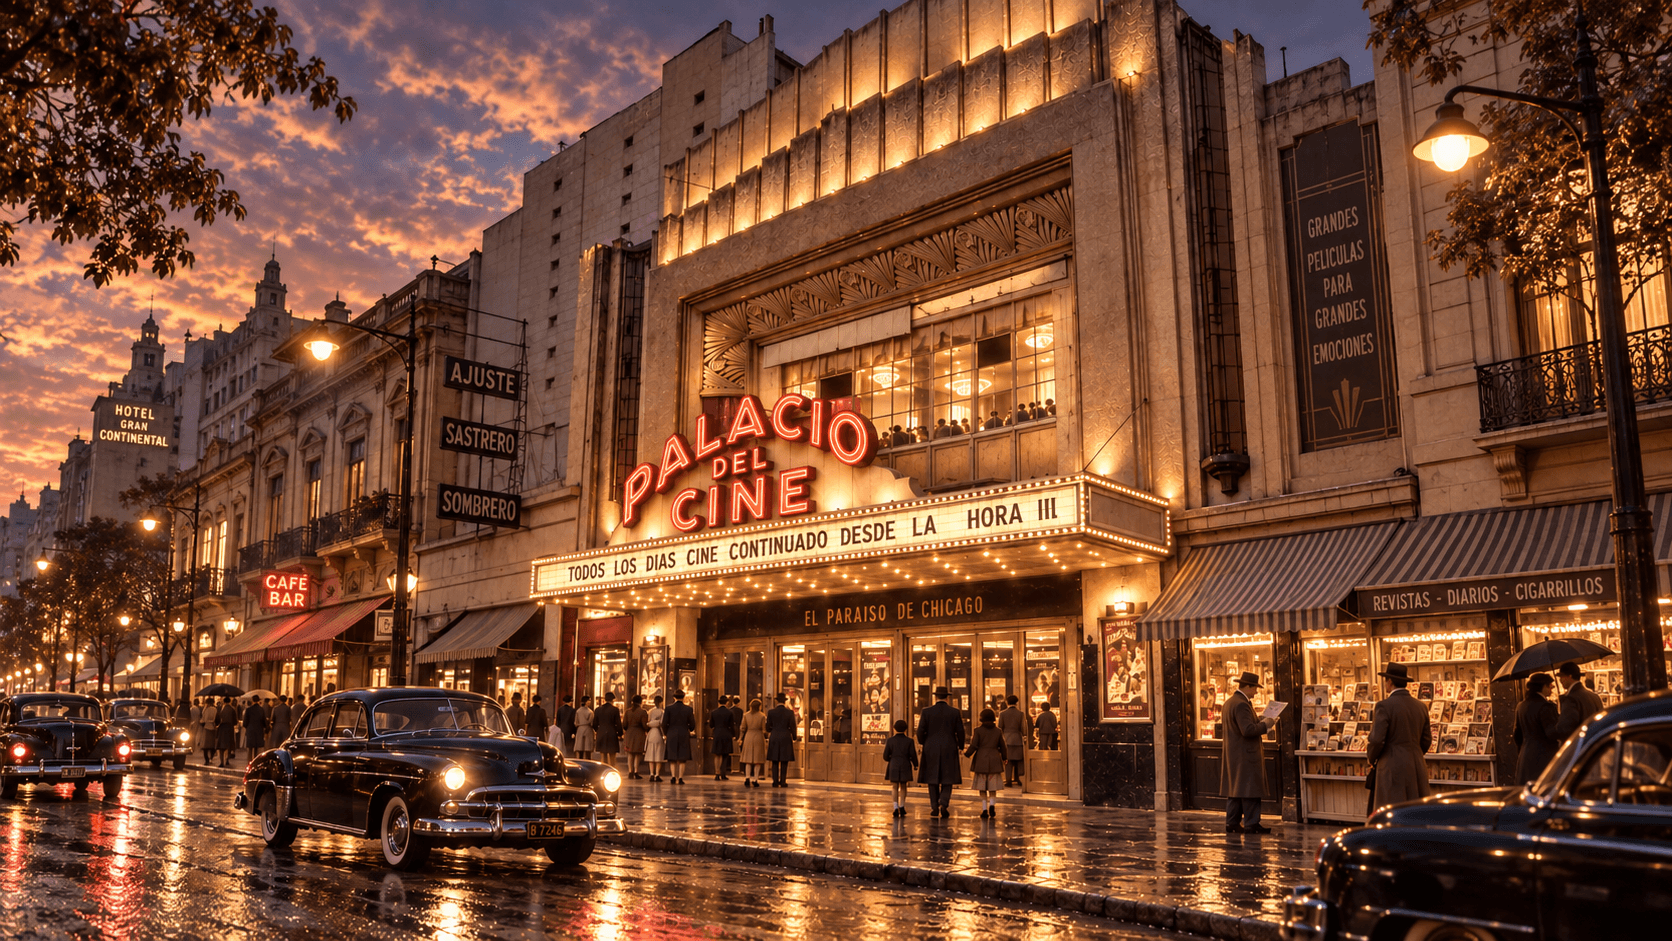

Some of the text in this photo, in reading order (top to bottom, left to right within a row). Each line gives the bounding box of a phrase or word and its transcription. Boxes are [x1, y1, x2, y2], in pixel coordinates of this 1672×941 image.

[1307, 206, 1359, 238] GRANDES
[1307, 239, 1365, 273] PELICULAS
[1323, 272, 1354, 298] PARA
[1315, 298, 1367, 329] GRANDES
[1313, 333, 1375, 365] EMOCIONES
[450, 362, 516, 394] AJUSTE
[115, 404, 155, 420] HOTEL
[120, 419, 148, 431] GRAN
[99, 429, 169, 447] CONTINENTAL
[445, 423, 515, 454] SASTRERO
[623, 393, 871, 528] PALACIO
[711, 447, 767, 480] DEL
[442, 490, 516, 521] SOMBRERO
[671, 465, 810, 532] CINE
[568, 562, 605, 582] TODOS
[614, 558, 637, 576] LOS
[646, 551, 676, 572] DIAS
[686, 546, 718, 566] CINE
[729, 530, 828, 560] CONTINUADO
[840, 520, 896, 546] DESDE
[912, 515, 937, 537] LA
[967, 503, 1023, 530] HORA
[265, 574, 308, 591] CAFÉ
[1373, 591, 1431, 611] REVISTAS
[1447, 585, 1499, 606] DIARIOS
[1515, 577, 1603, 600] CIGARRILLOS
[269, 591, 305, 607] BAR
[804, 596, 983, 627] EL PARAISO DE CHICAGO
[540, 824, 562, 836] 7246
